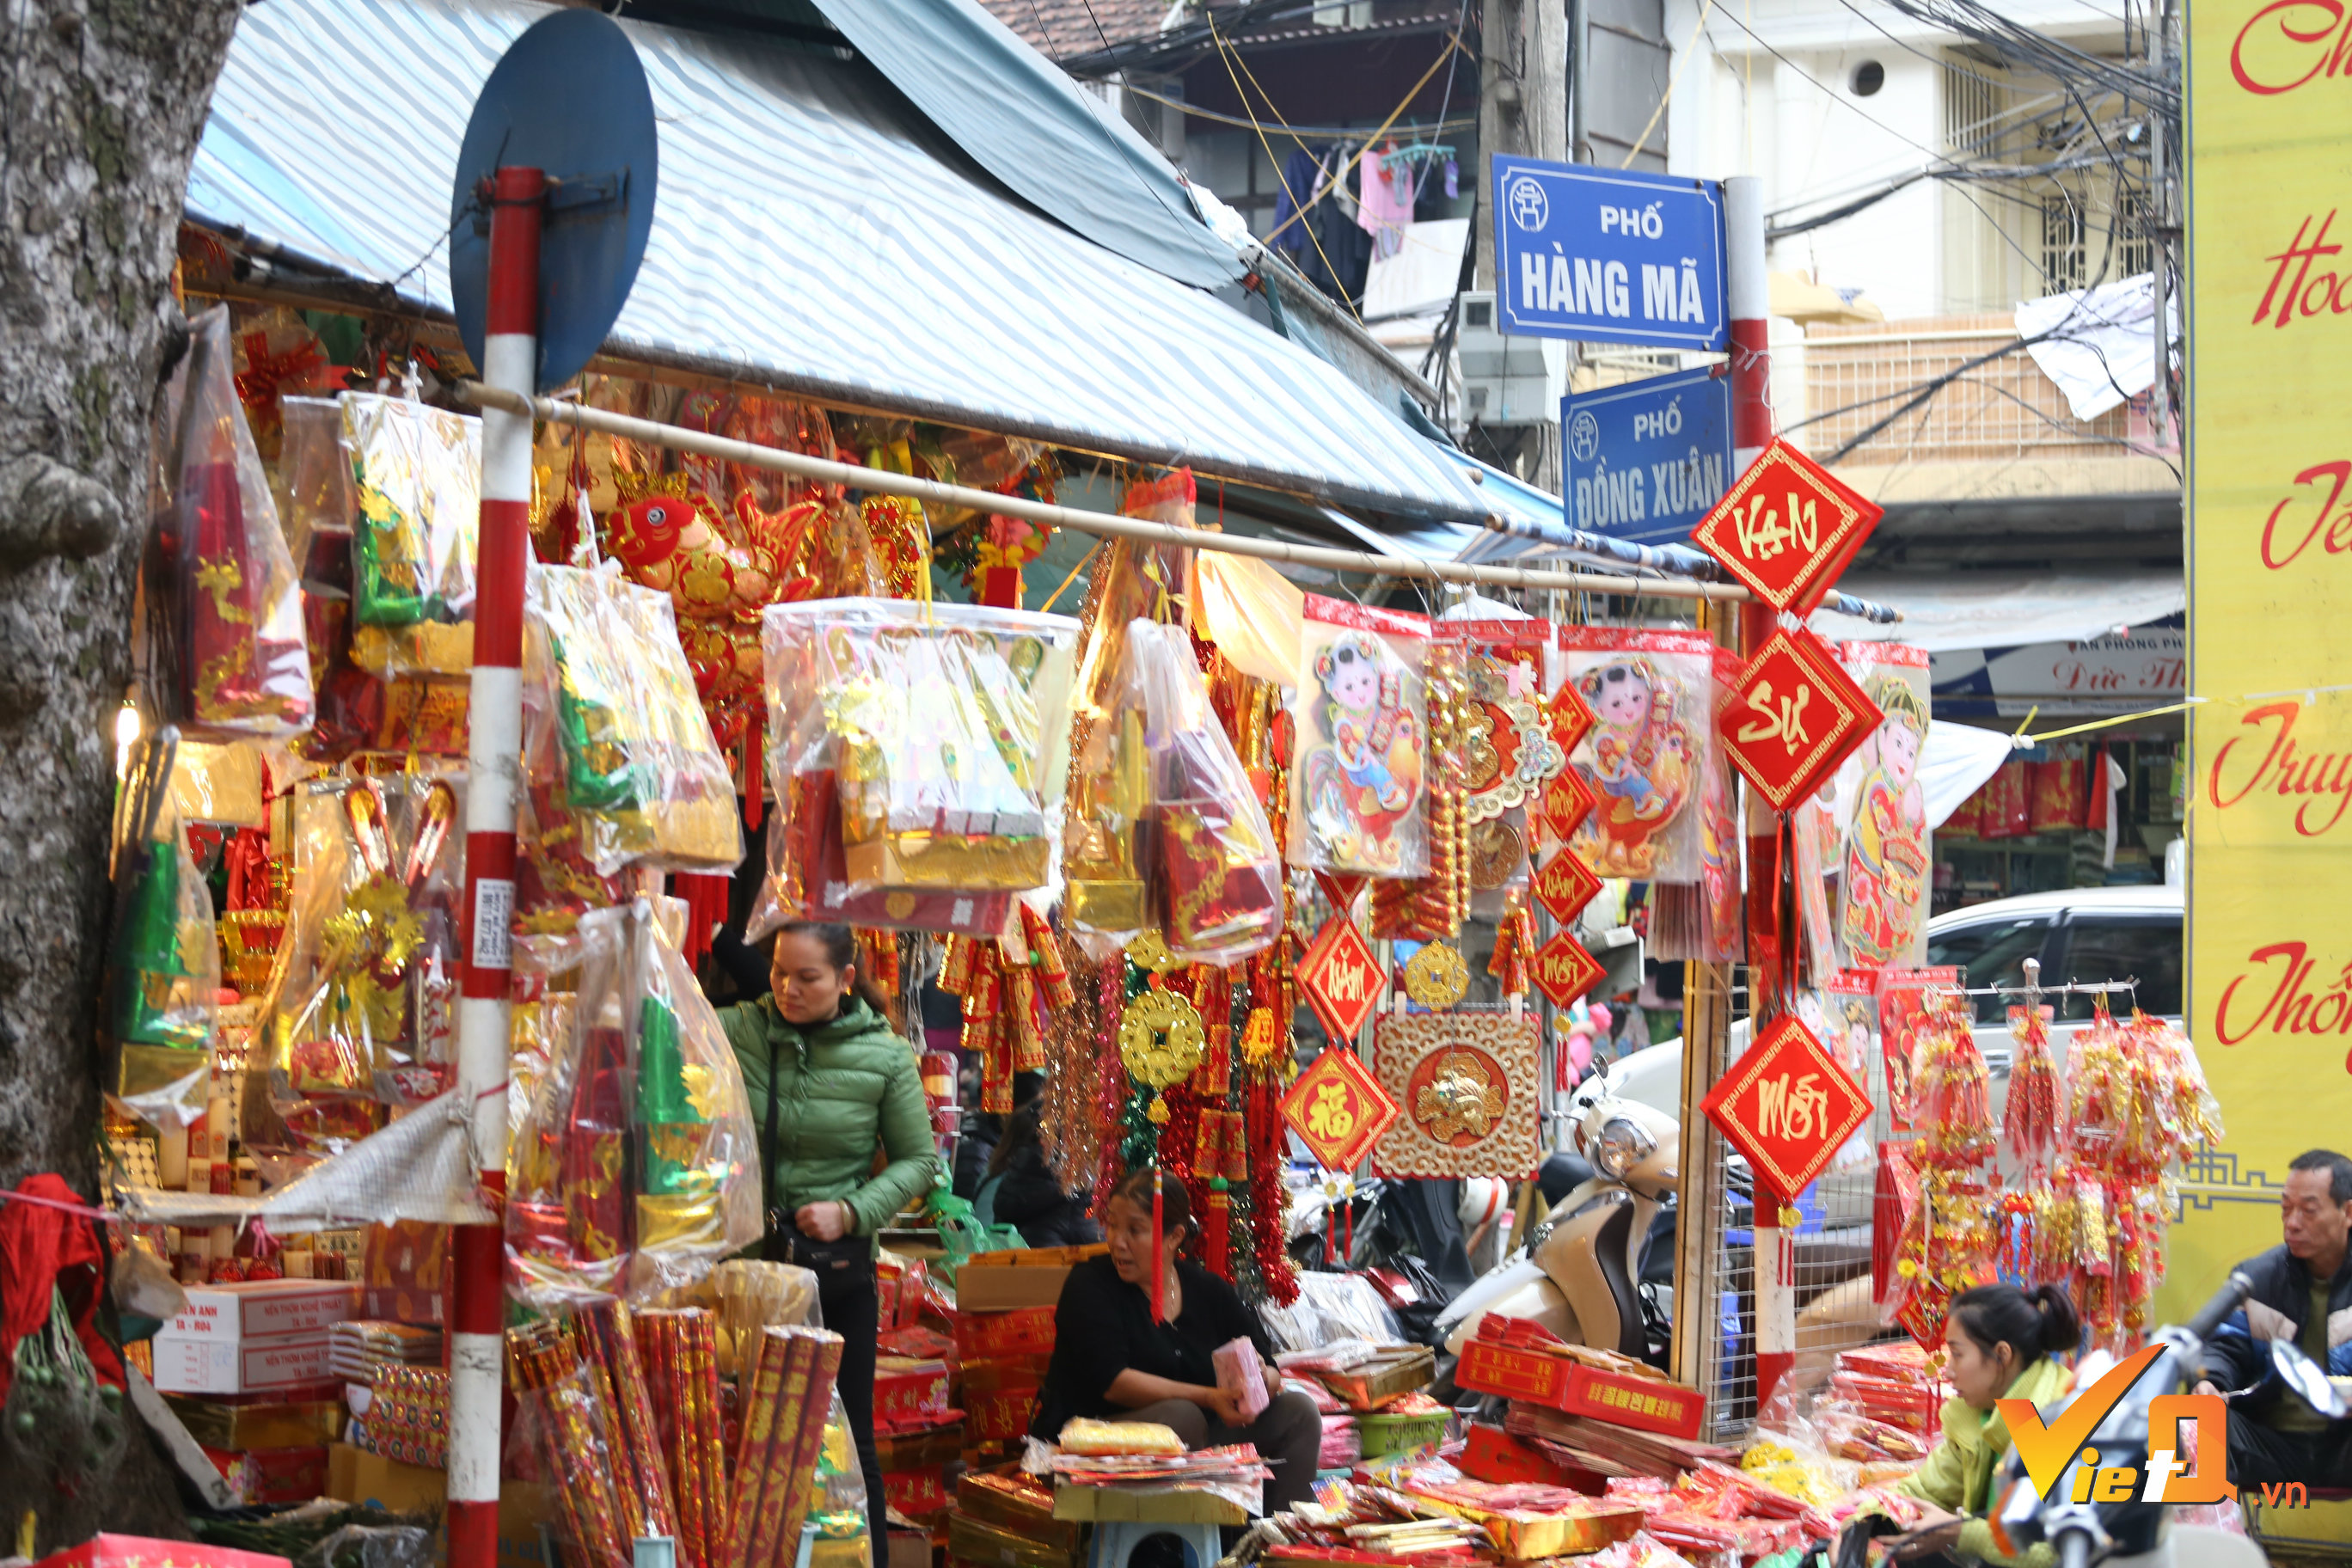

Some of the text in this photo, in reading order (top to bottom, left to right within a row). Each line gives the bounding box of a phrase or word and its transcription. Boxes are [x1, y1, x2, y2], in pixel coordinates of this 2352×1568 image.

[1600, 200, 1664, 240] PHỐ
[1521, 241, 1706, 324] HÀNG MÃ
[1633, 397, 1682, 442] PHỐ
[1576, 445, 1724, 530] ĐỒNG XUÂN
[1732, 492, 1817, 560] VẠN
[1737, 679, 1810, 756] SỰ
[1329, 945, 1366, 1003] NĂM
[2215, 940, 2352, 1075] Thố
[1308, 1080, 1354, 1142] 福
[1758, 1074, 1828, 1140] MỚI
